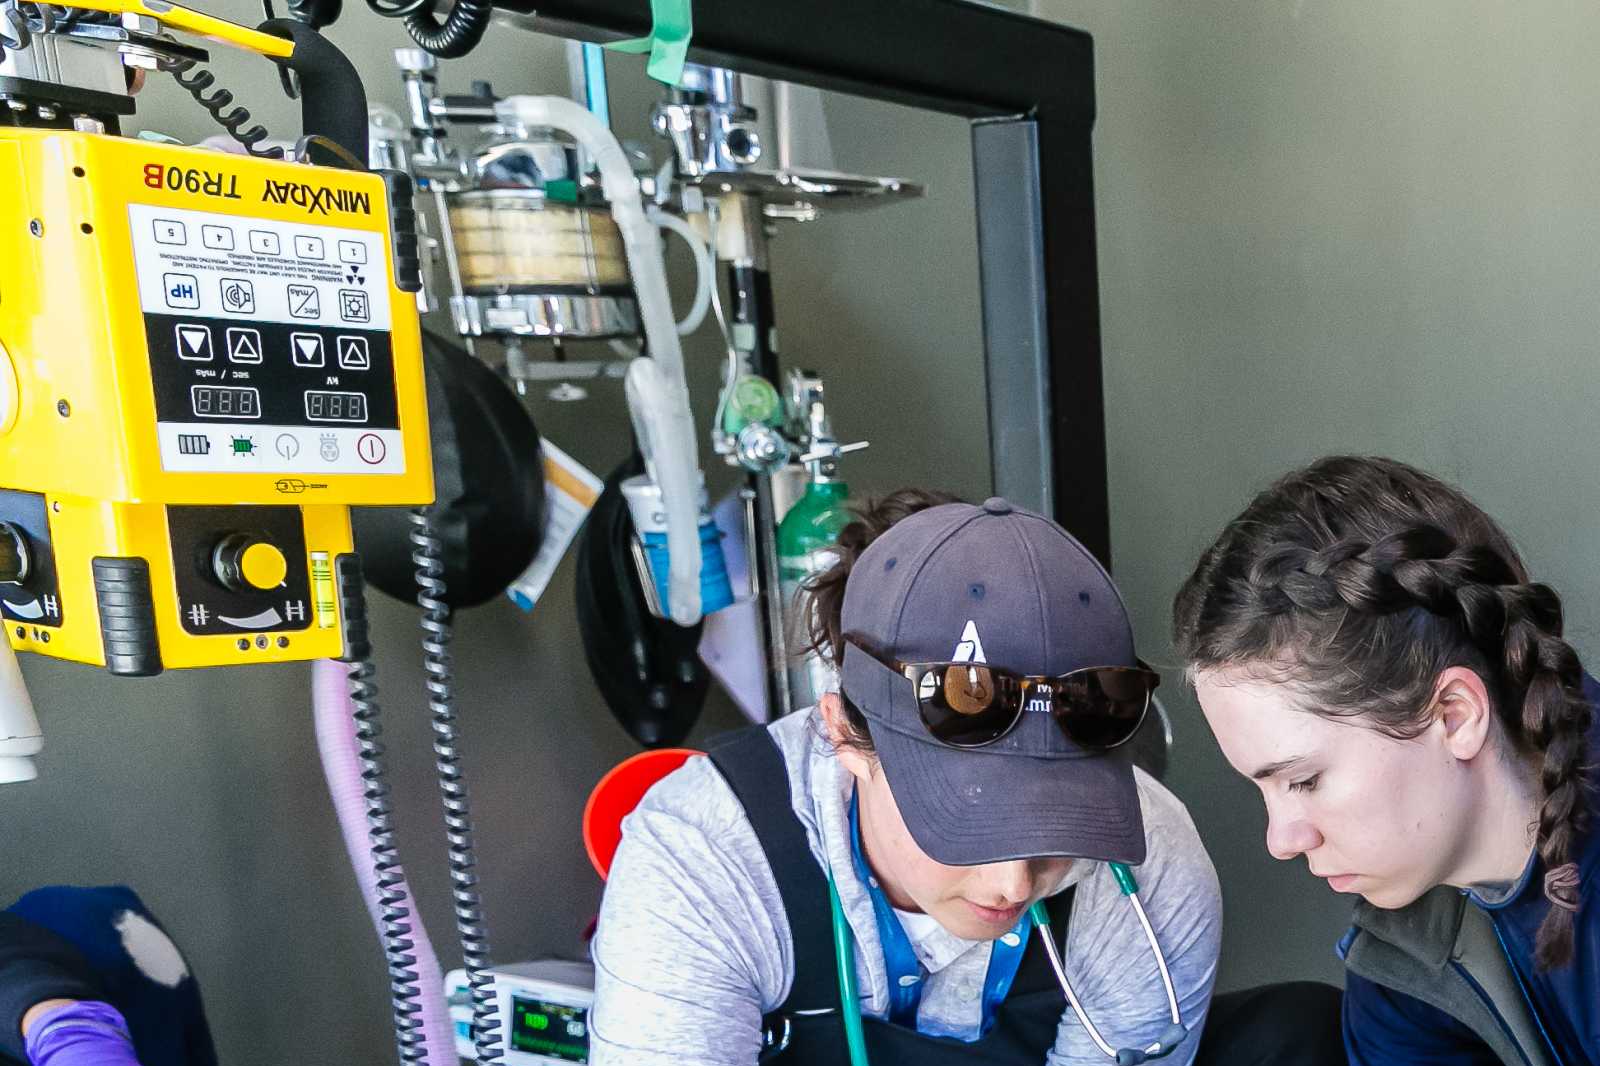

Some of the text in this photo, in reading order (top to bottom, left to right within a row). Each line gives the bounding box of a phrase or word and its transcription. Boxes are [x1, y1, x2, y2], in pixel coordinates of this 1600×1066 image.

[143, 163, 241, 199] TR90B
[168, 228, 174, 237] 5
[216, 234, 222, 242] 4
[263, 239, 268, 247] 3
[170, 284, 193, 299] HP
[290, 288, 308, 297] mAs
[304, 307, 318, 316] sec
[195, 369, 215, 378] mAs
[232, 371, 249, 380] sec
[326, 376, 338, 385] kV
